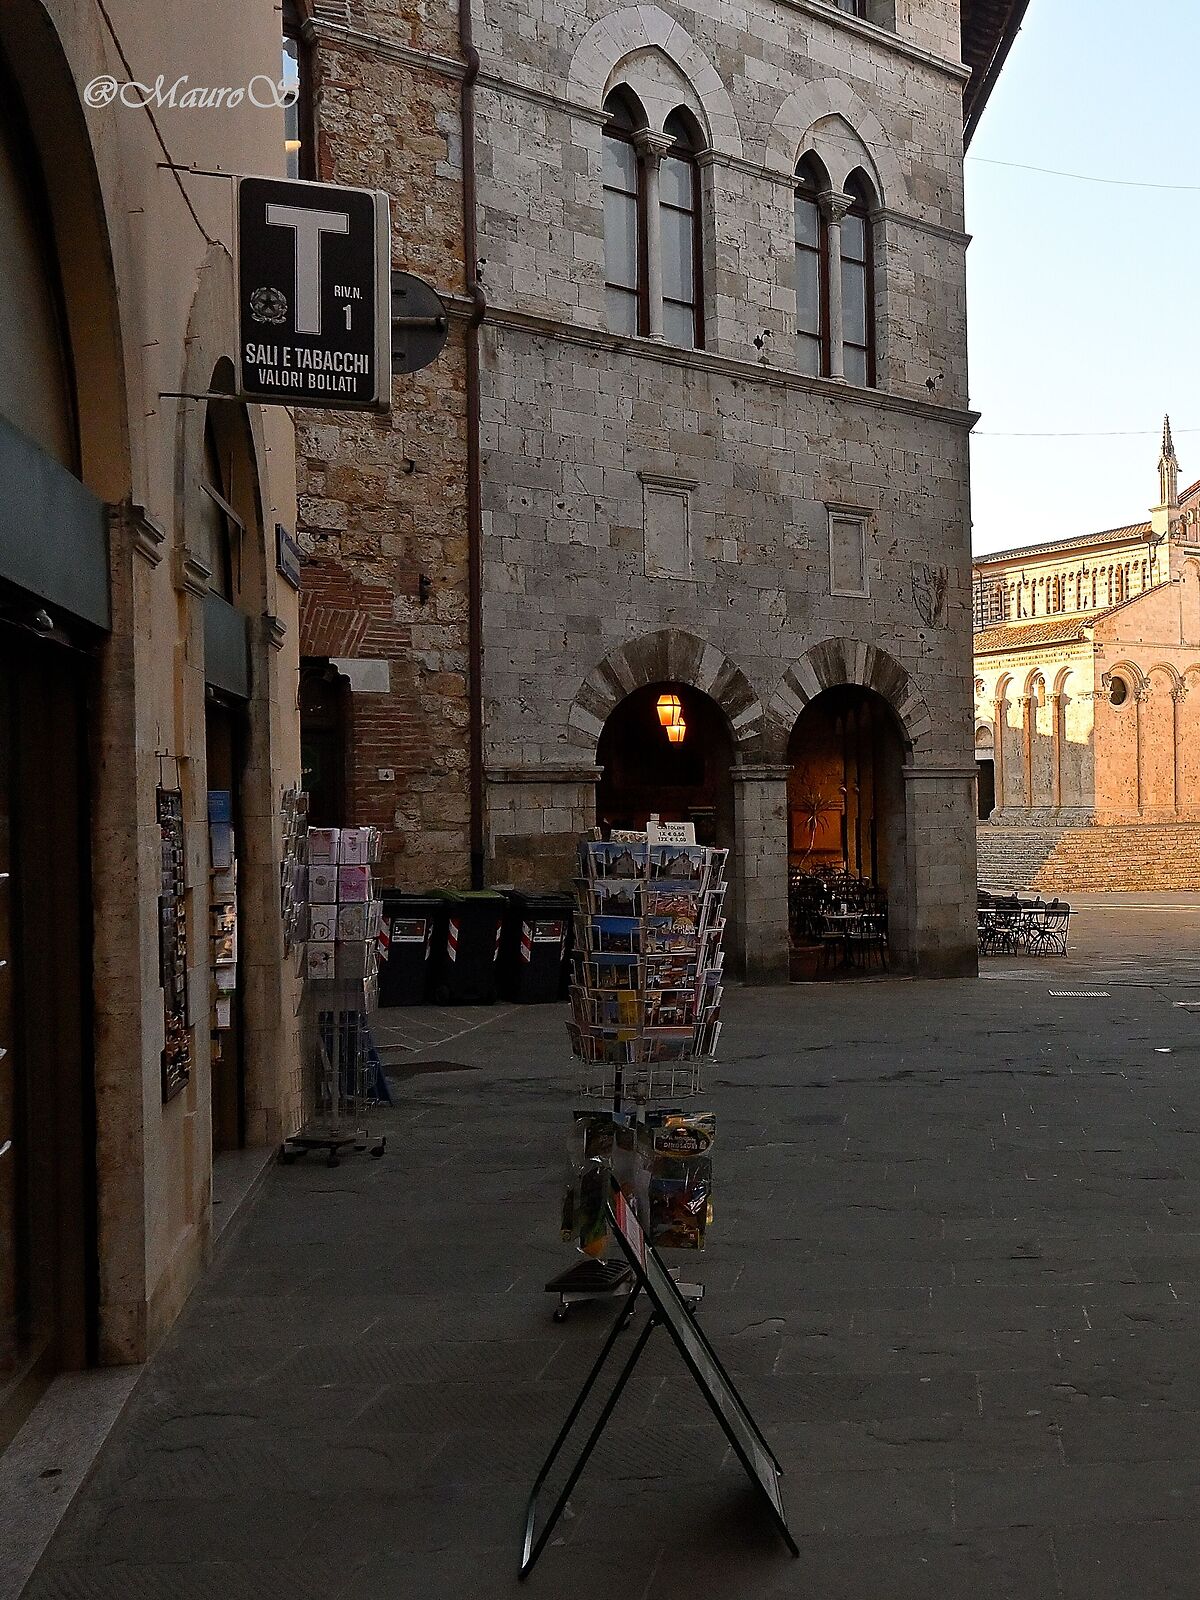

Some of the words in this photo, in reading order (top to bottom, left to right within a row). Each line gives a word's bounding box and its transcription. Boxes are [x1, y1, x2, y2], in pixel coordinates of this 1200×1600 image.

[265, 203, 350, 336] T
[342, 304, 352, 331] 1
[245, 343, 278, 366] SALI
[283, 347, 291, 367] E
[294, 347, 369, 375] TABACCHI
[258, 368, 303, 388] VALORI
[308, 373, 357, 393] BOLLATI
